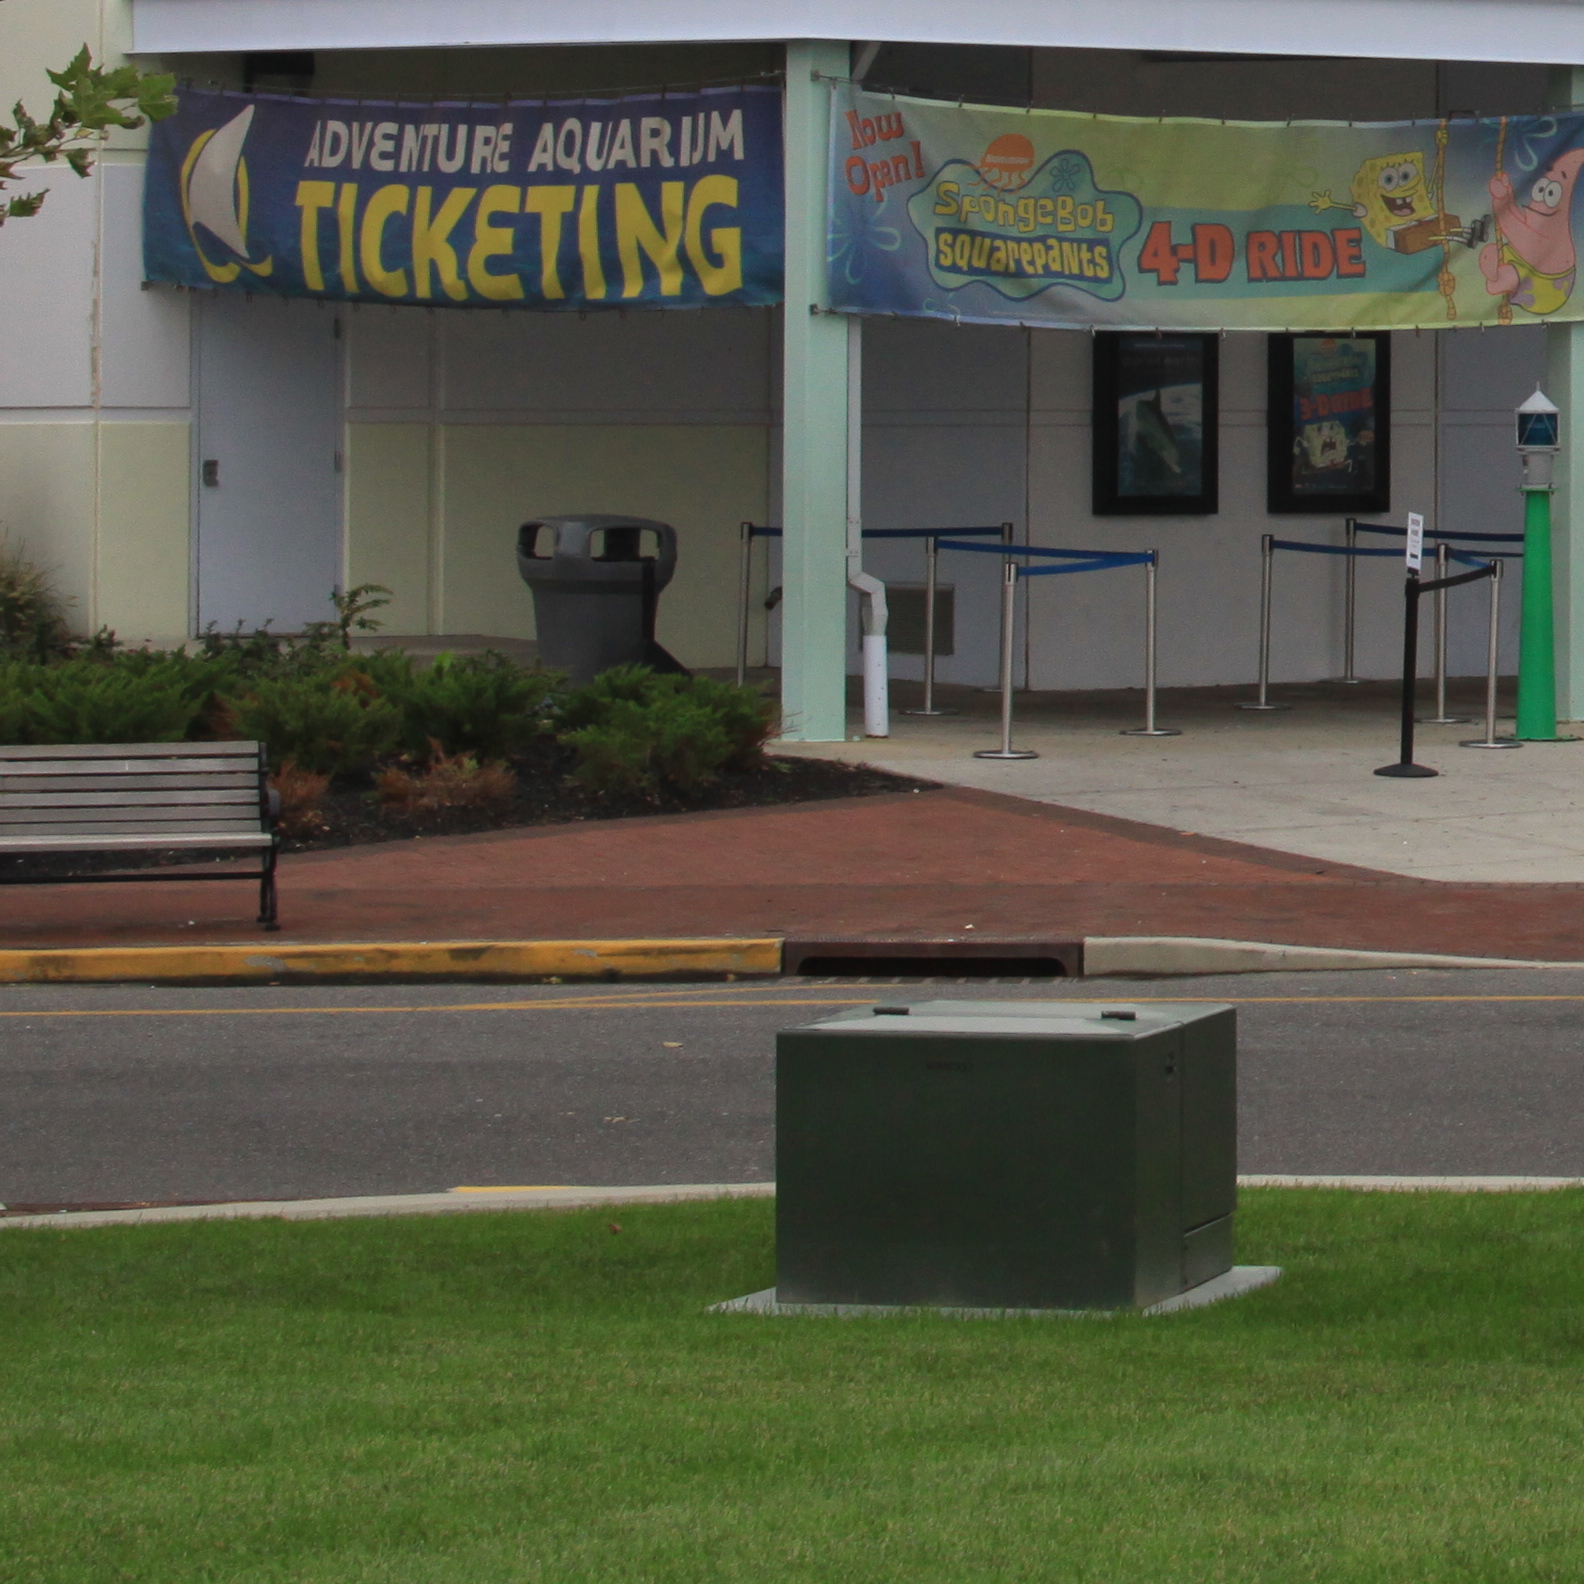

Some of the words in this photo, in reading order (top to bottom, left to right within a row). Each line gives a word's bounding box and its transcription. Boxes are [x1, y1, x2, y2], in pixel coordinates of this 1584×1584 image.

[305, 120, 514, 174] ADVENTURE
[845, 109, 904, 150] Now
[845, 141, 926, 203] Open!
[934, 181, 1115, 233] SpongeBob
[295, 174, 743, 301] TICKETING
[1138, 220, 1236, 286] 4-D
[1246, 227, 1366, 283] RIDE
